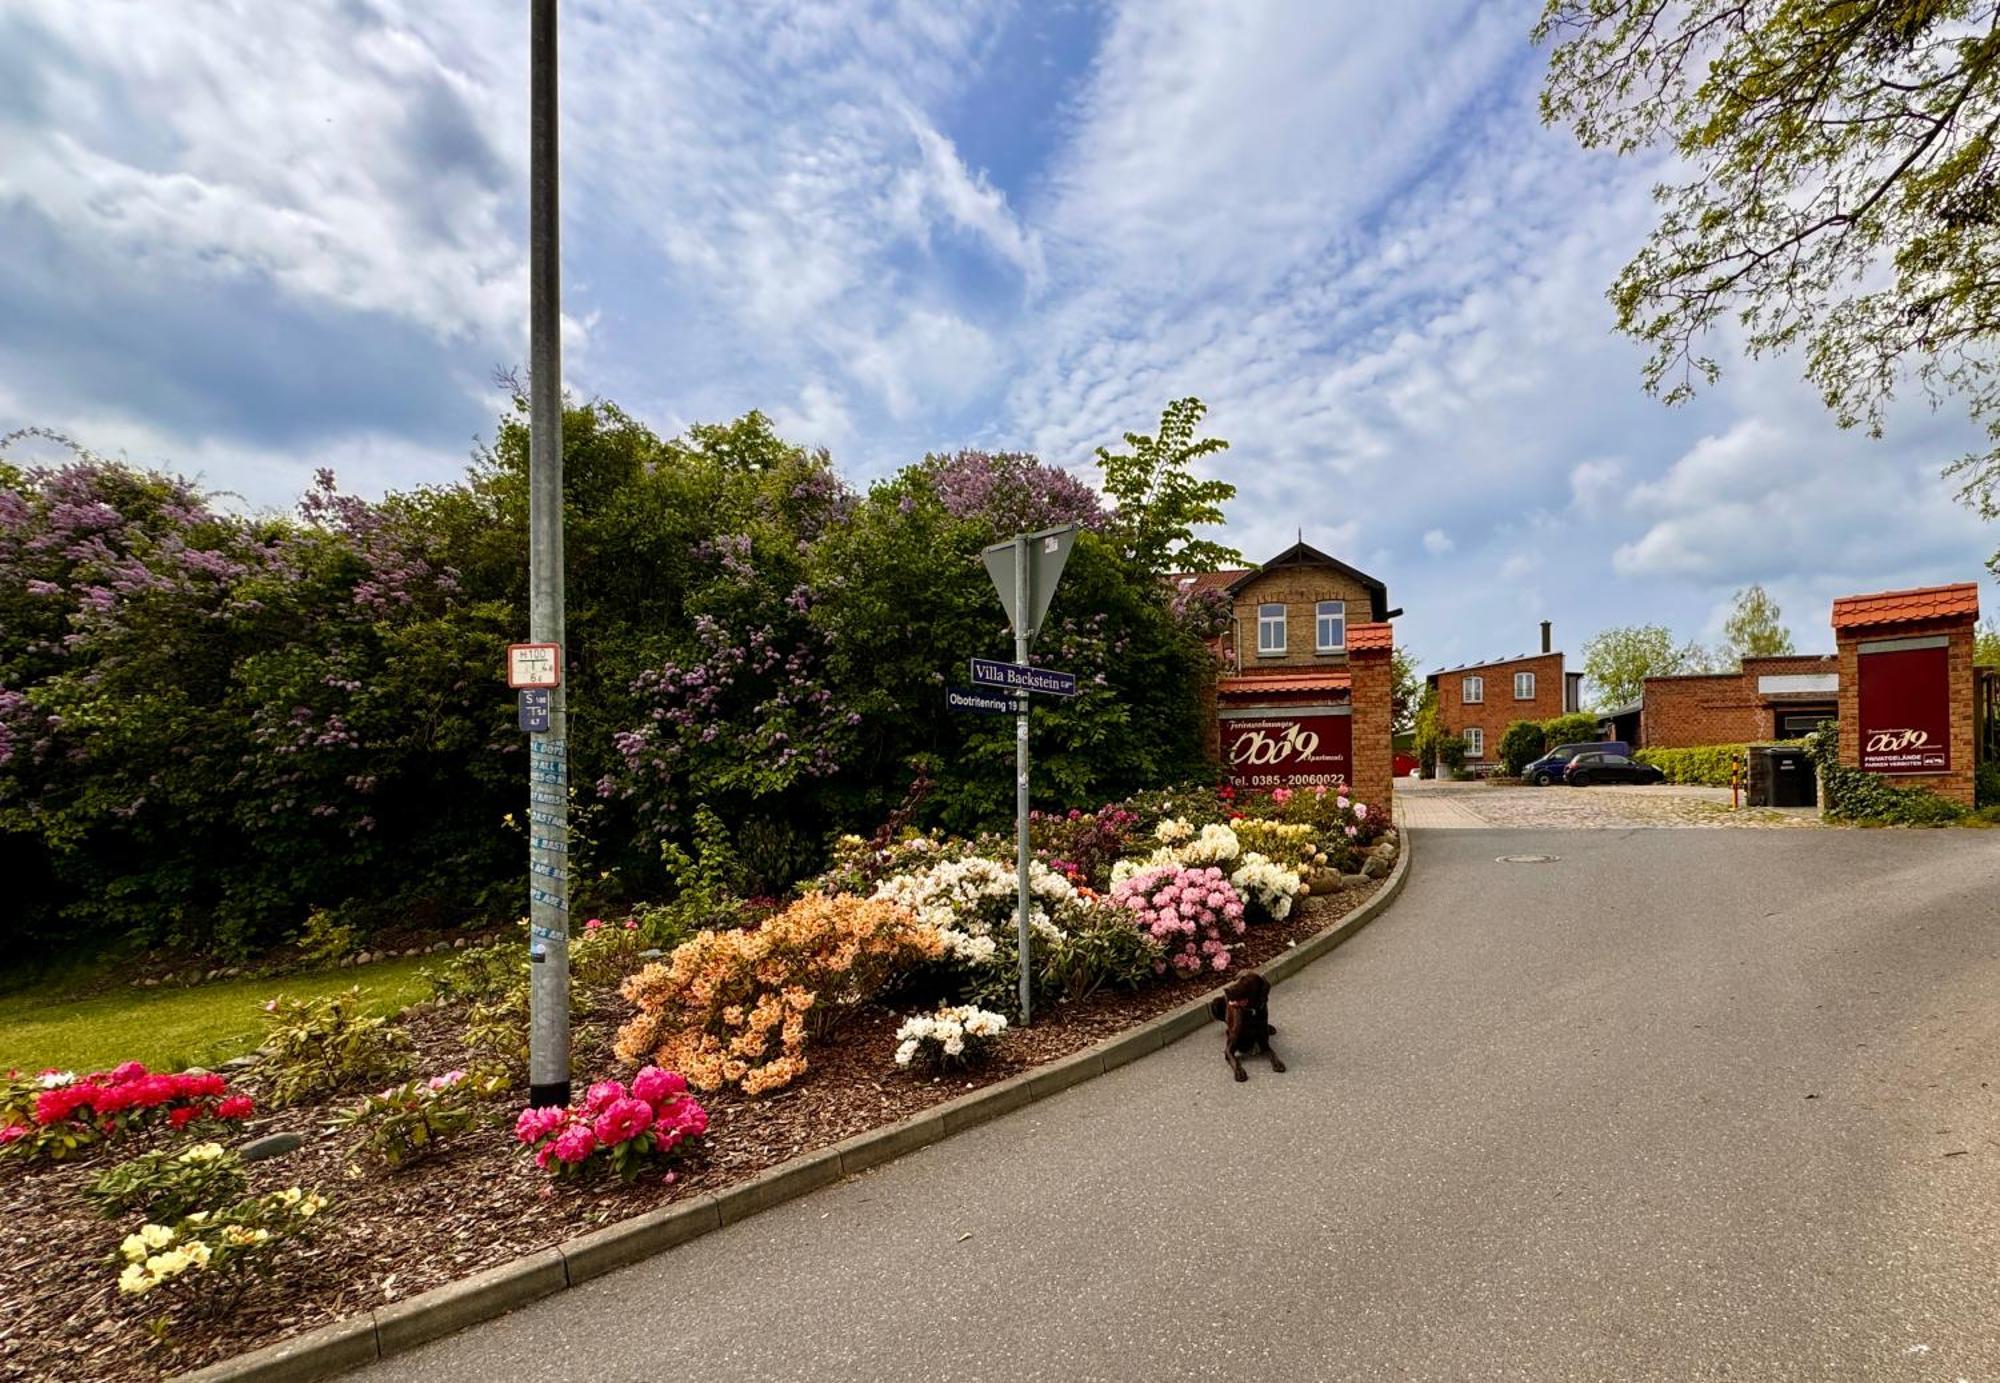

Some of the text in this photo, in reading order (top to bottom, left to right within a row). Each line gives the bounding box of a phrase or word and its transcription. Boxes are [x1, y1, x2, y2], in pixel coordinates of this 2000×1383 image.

[520, 649, 546, 659] H100
[976, 665, 1060, 690] Villa Backstein
[949, 693, 1018, 712] Obotritenring 19
[1229, 774, 1345, 786] Tel. 0385-20060022
